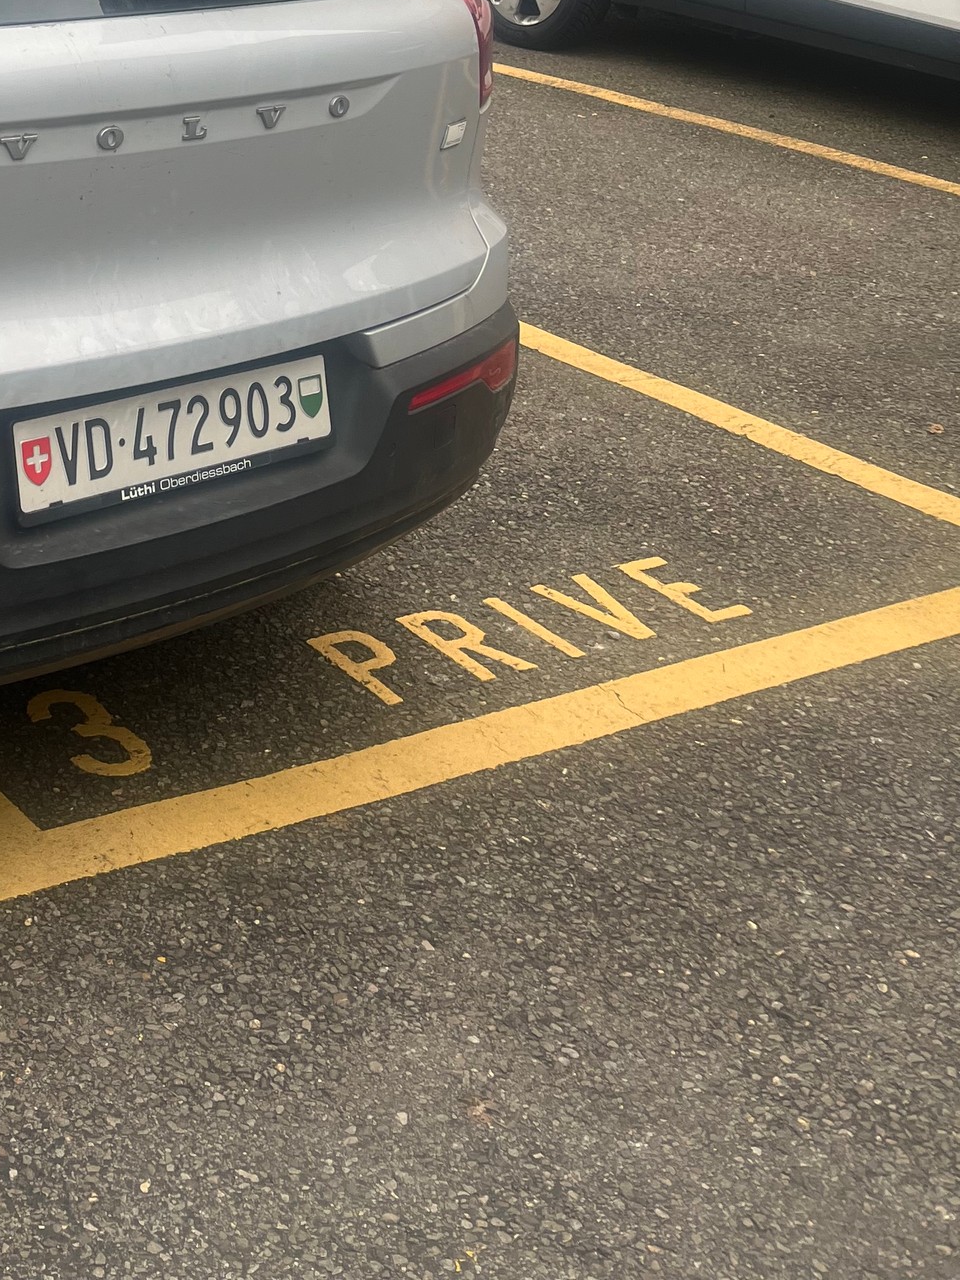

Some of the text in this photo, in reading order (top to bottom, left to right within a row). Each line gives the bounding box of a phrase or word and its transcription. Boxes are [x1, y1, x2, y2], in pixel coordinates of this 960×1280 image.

[0, 95, 350, 161] VOLVO
[121, 458, 253, 501] Lüthi Oberdiessbach
[26, 556, 753, 778] 3 PRIVE
